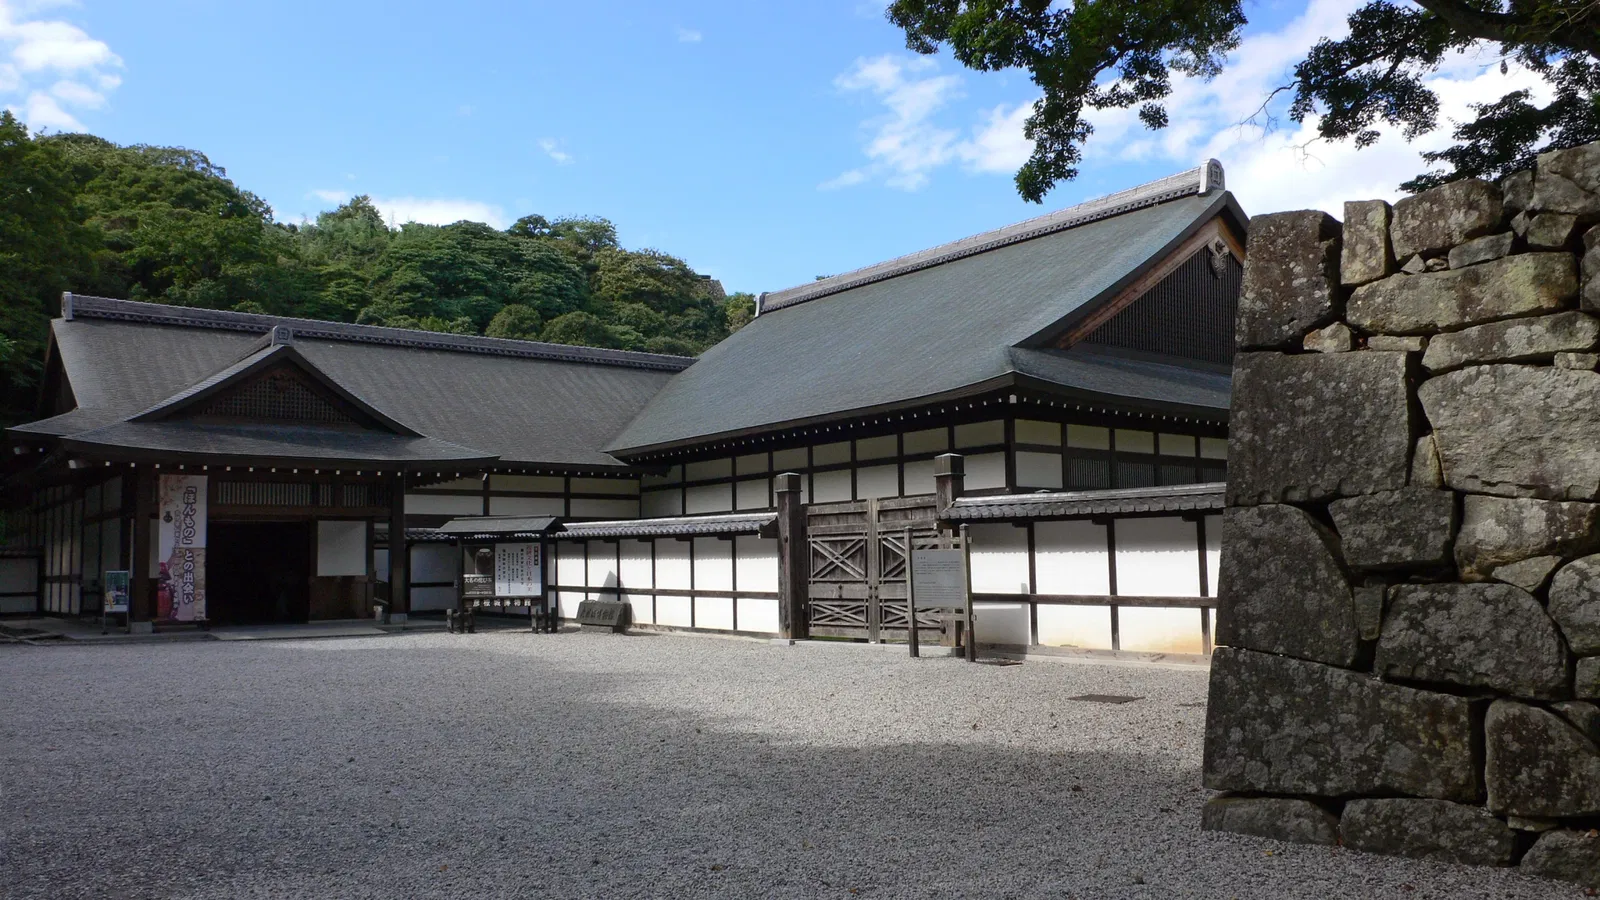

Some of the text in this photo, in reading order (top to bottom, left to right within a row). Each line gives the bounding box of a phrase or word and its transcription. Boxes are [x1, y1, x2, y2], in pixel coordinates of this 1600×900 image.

[182, 486, 197, 604] 「ほんもの」との出会い
